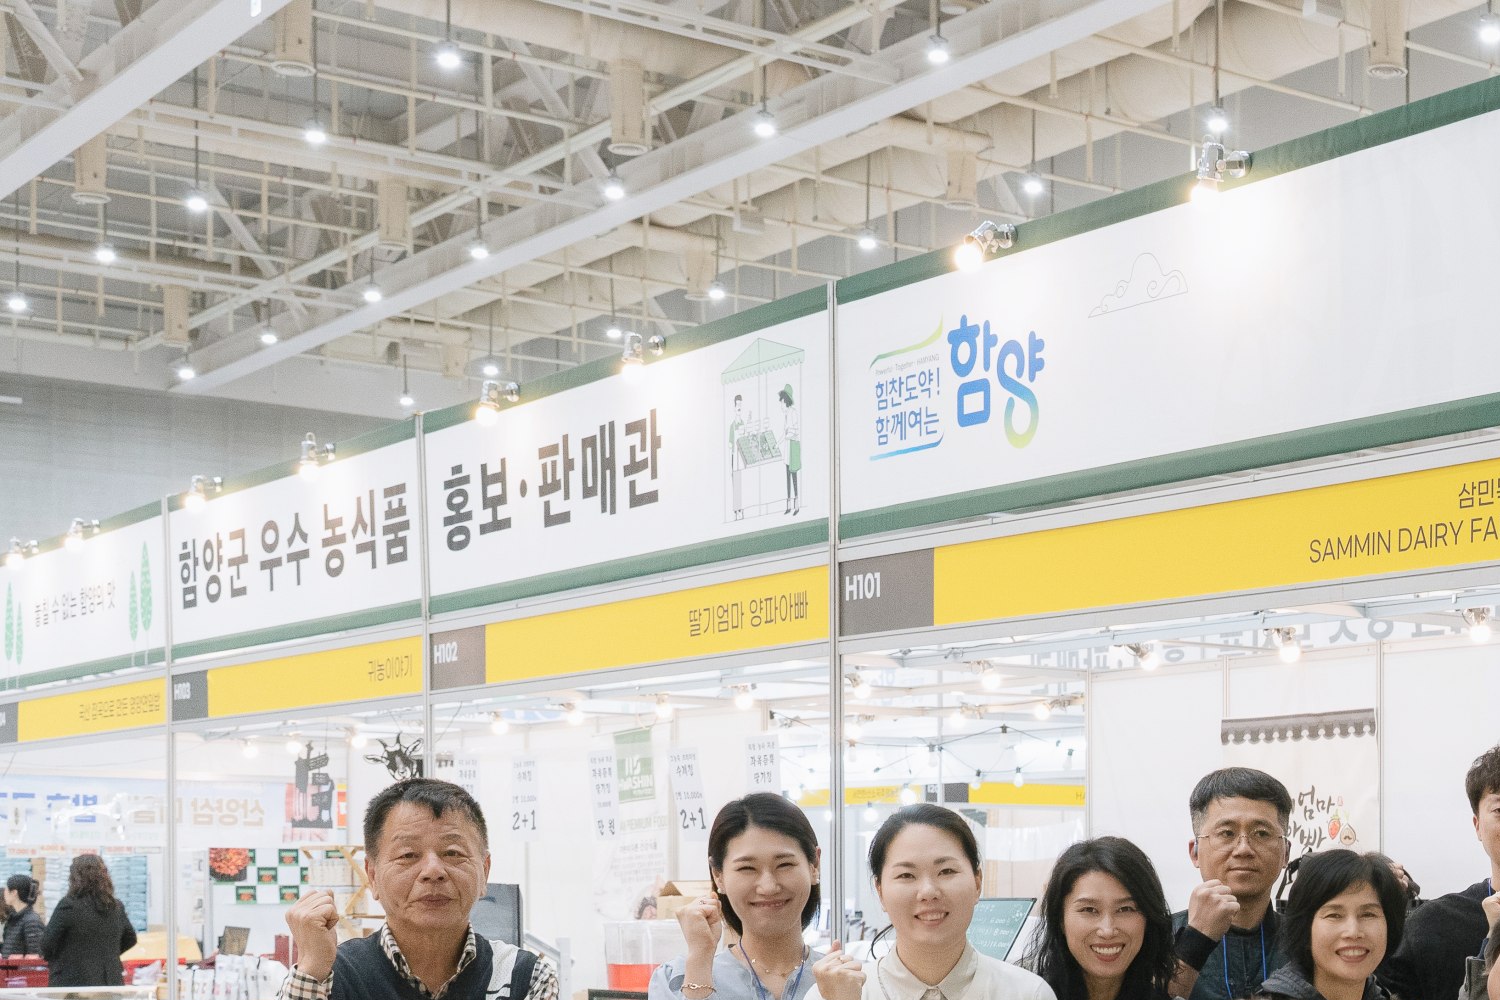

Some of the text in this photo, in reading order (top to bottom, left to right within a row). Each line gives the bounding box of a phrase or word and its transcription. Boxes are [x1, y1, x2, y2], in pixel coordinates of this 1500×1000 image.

[875, 367, 940, 411] 힘찬도약!
[947, 314, 1045, 449] 함양
[875, 406, 939, 446] 함께여는
[179, 482, 410, 610] 함양군 우수 농식품
[1309, 528, 1392, 564] SAMMIN
[1399, 520, 1464, 553] DAIRY
[845, 572, 881, 601] H101
[689, 590, 808, 637] 딸기엄마 양파아빠
[367, 654, 412, 683] 귀농이야기
[434, 642, 458, 664] H102
[512, 810, 536, 830] 2+1
[680, 807, 706, 830] 2+1
